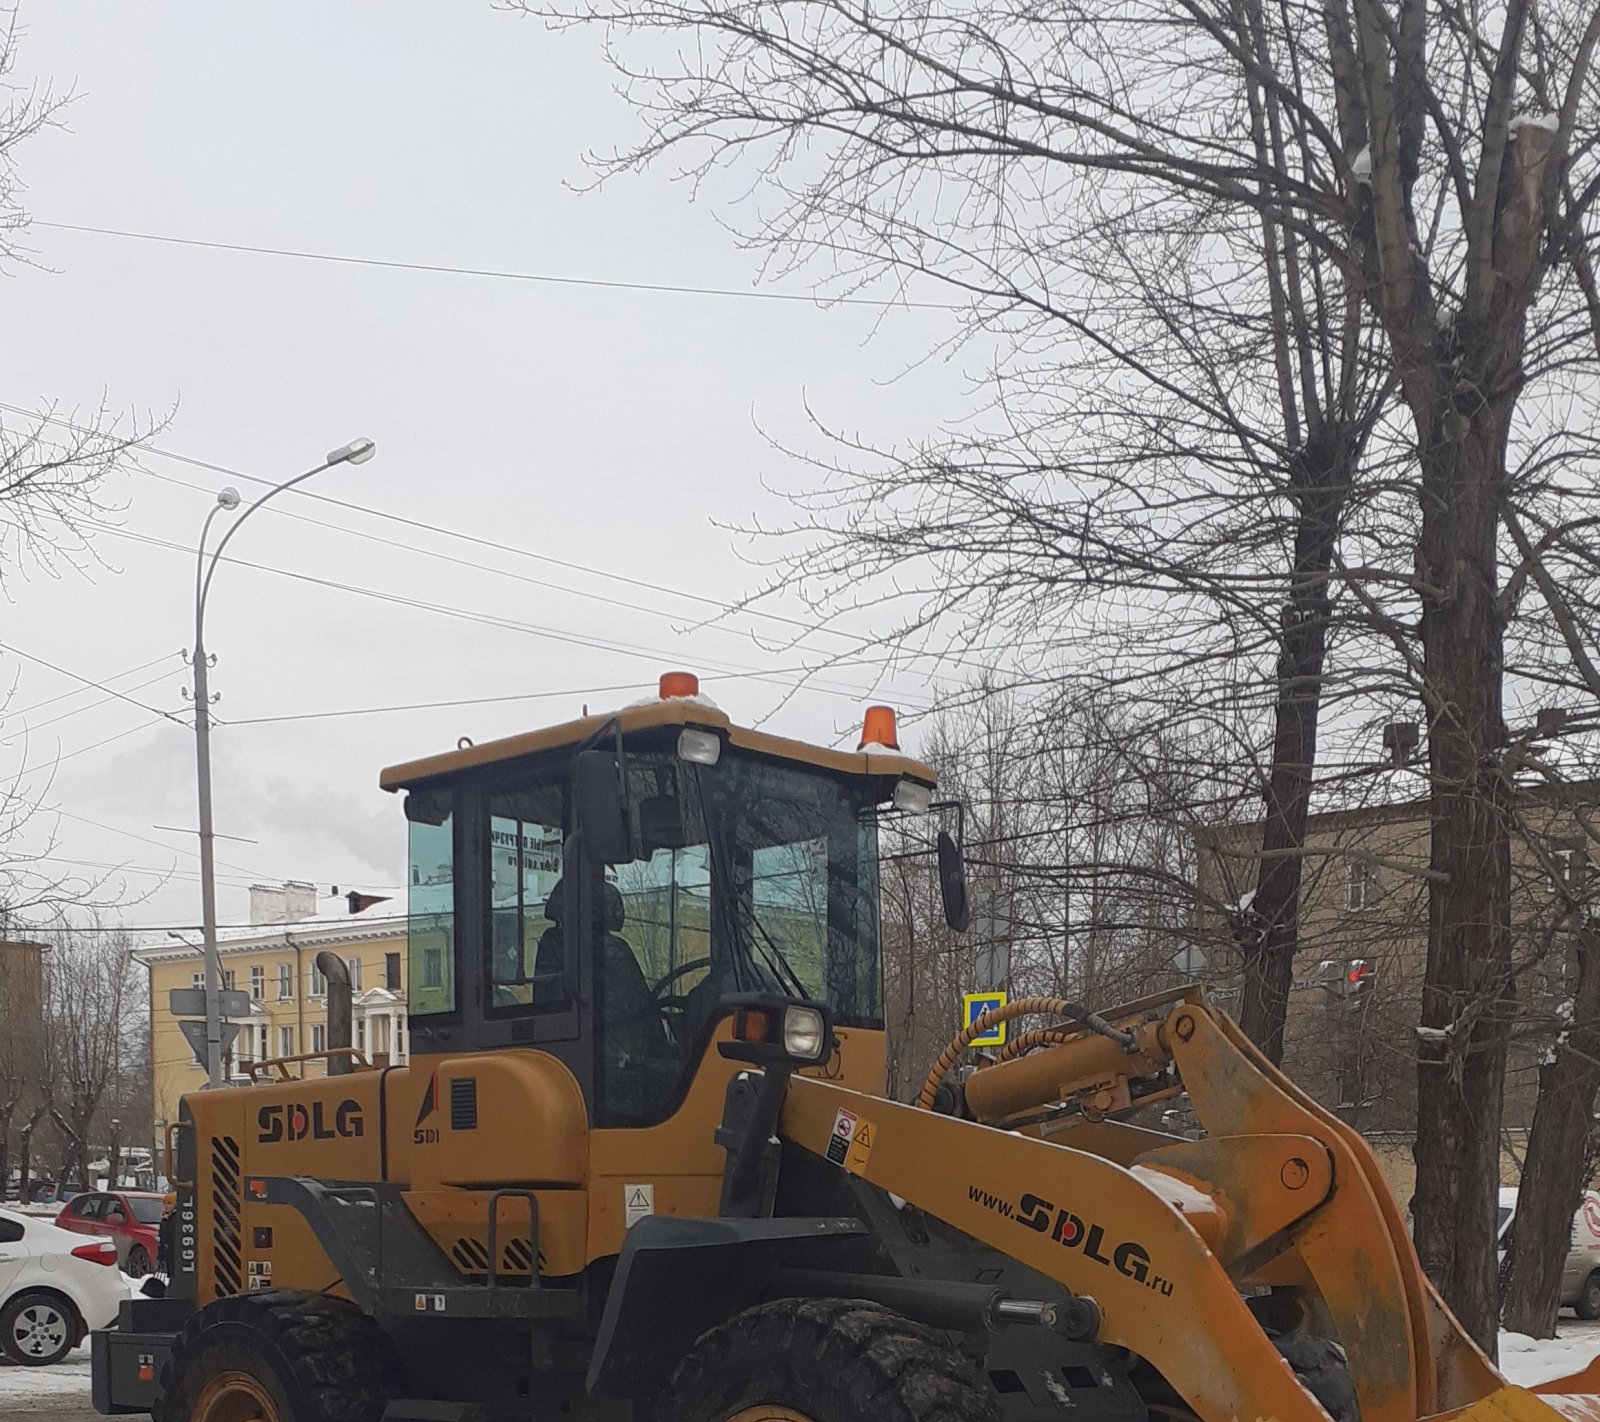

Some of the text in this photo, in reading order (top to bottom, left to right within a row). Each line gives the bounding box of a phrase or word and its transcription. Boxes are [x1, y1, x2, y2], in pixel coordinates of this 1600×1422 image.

[258, 1099, 364, 1143] SDLG
[182, 1195, 195, 1272] LG936L
[968, 1186, 1175, 1297] www.SDLG.ru
